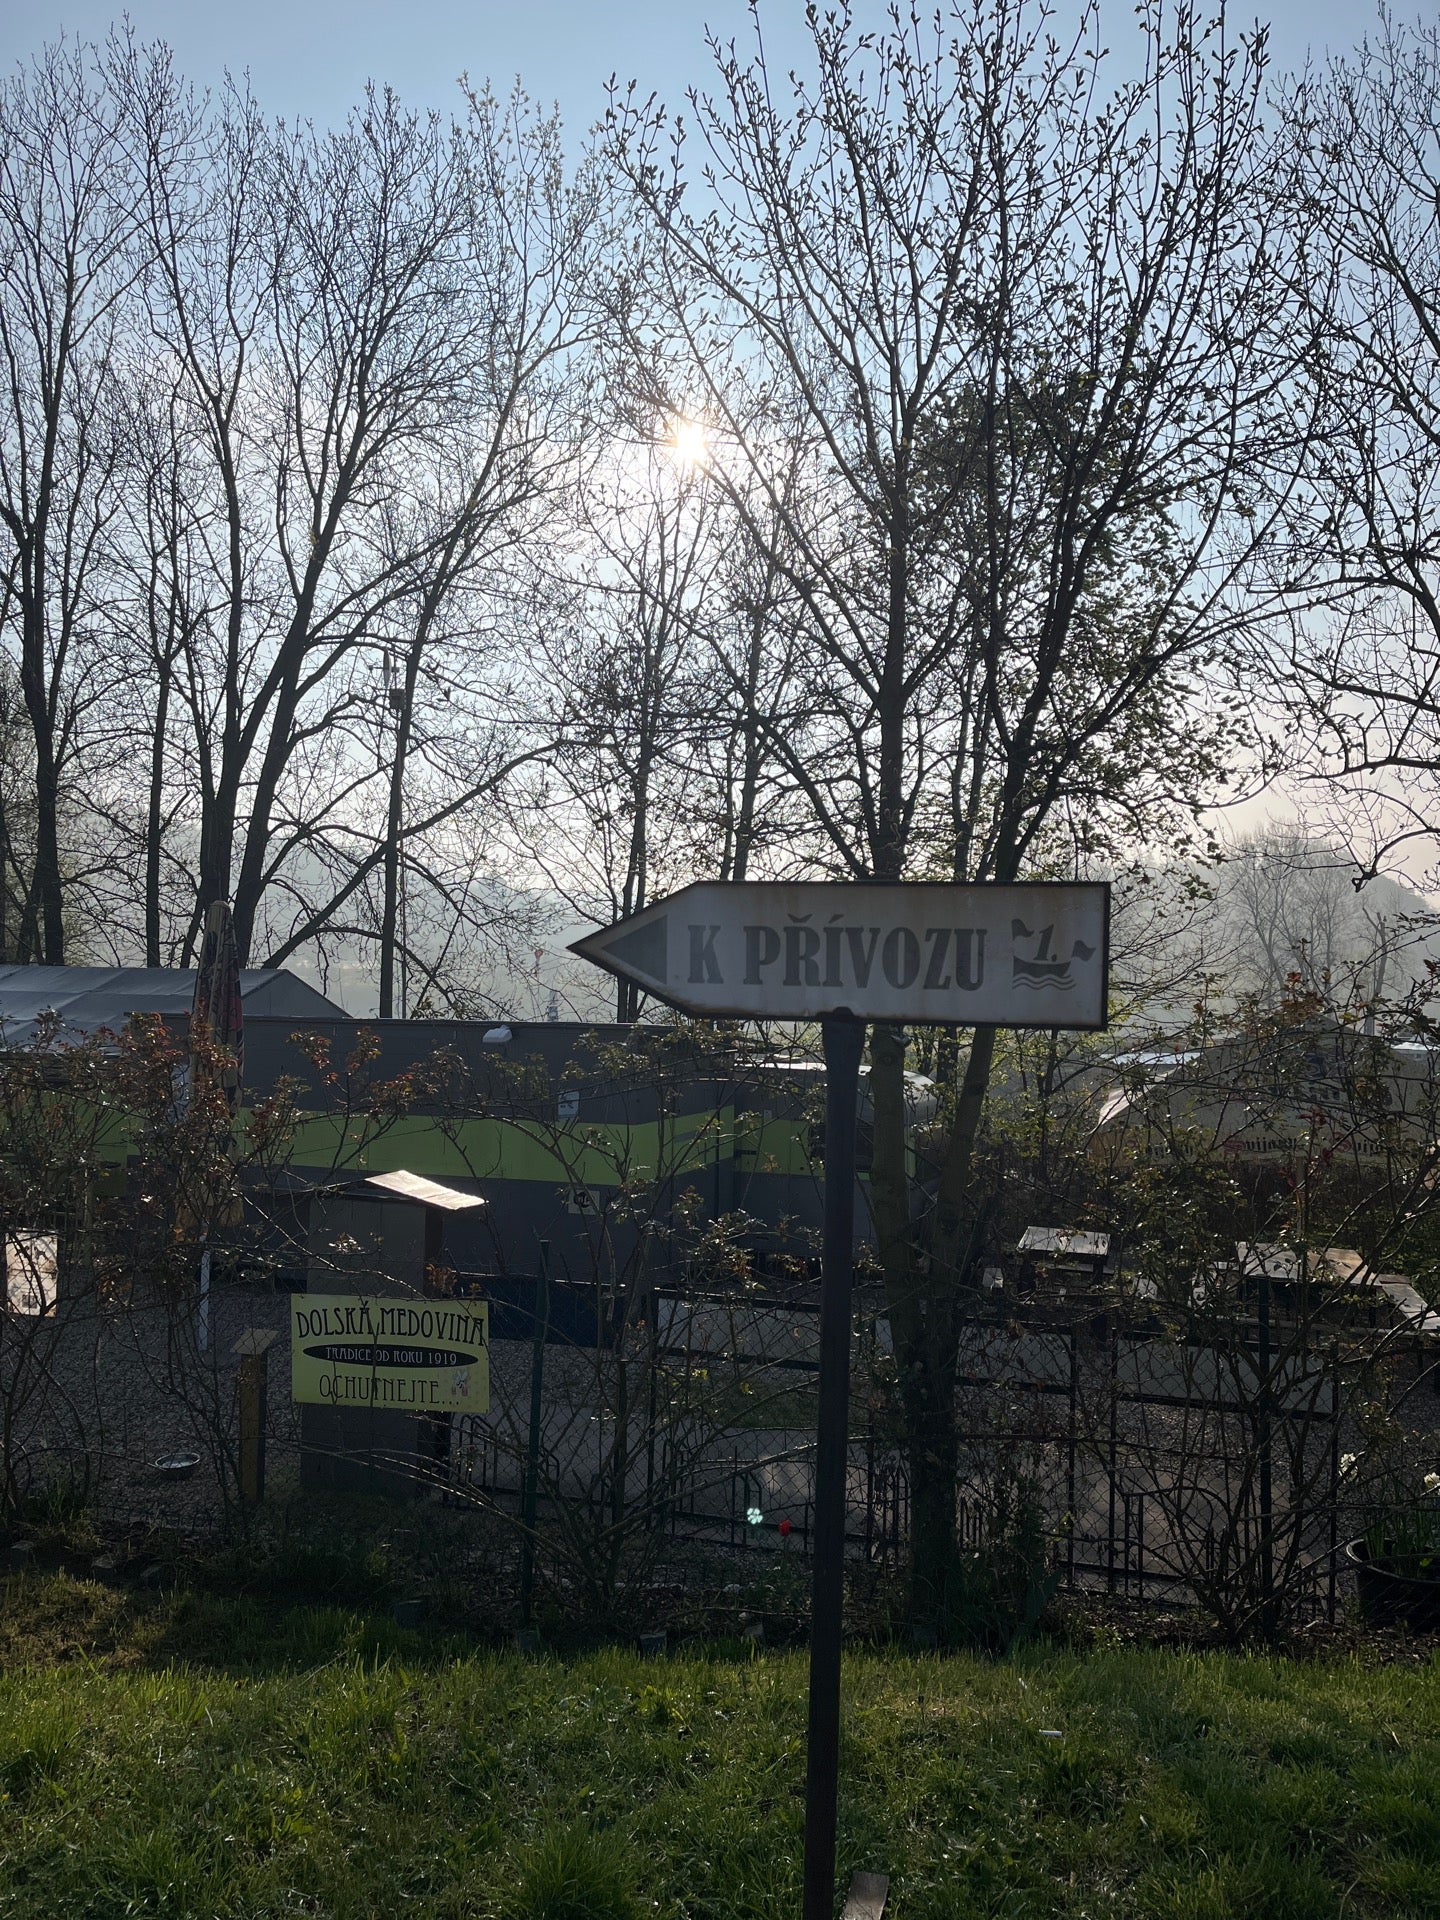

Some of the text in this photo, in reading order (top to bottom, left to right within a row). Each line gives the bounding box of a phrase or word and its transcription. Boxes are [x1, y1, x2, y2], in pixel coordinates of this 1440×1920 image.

[687, 913, 987, 990] K PŘÍVOZU
[296, 1301, 484, 1346] DOLSKÁ MEDOVINA
[326, 1347, 458, 1366] TRADICE OD ROKU 1919
